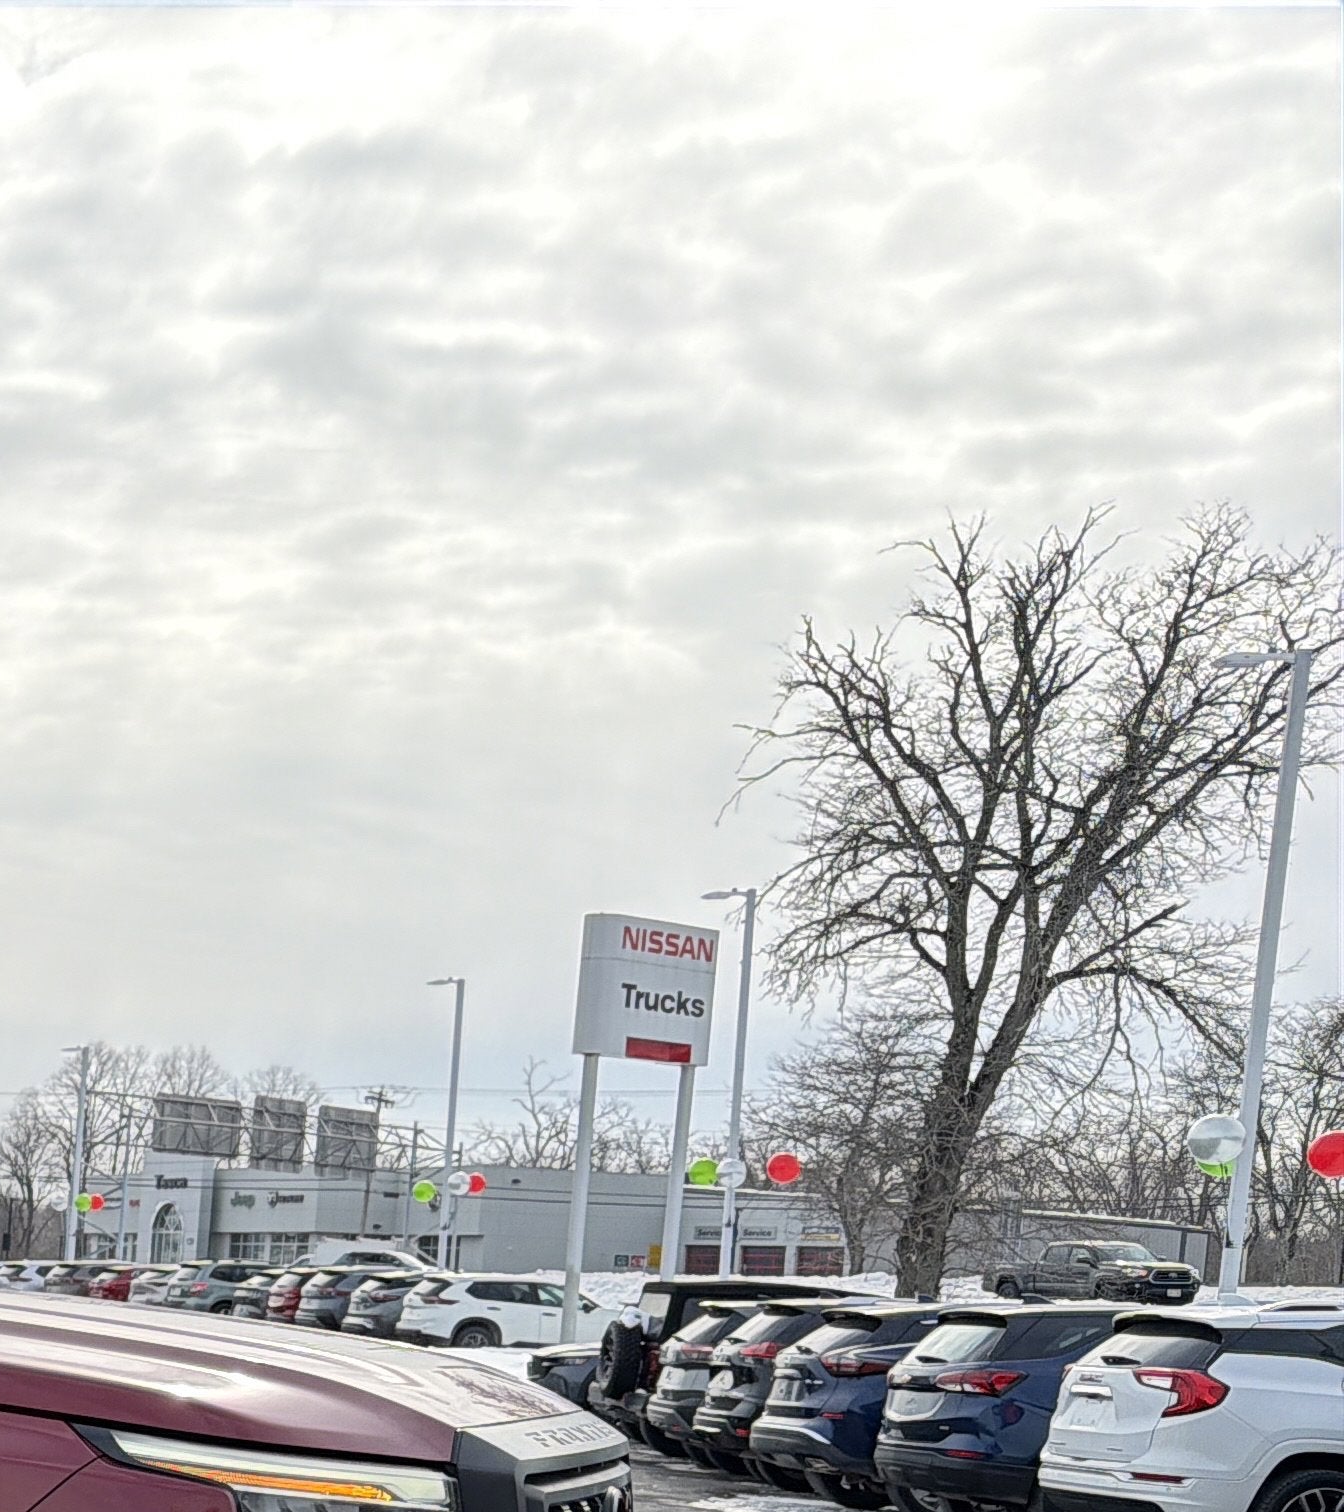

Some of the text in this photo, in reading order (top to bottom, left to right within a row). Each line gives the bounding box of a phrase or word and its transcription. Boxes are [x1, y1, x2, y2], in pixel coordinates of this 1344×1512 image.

[621, 925, 714, 962] NISSAN
[621, 982, 705, 1018] Trucks
[743, 1228, 772, 1237] Service
